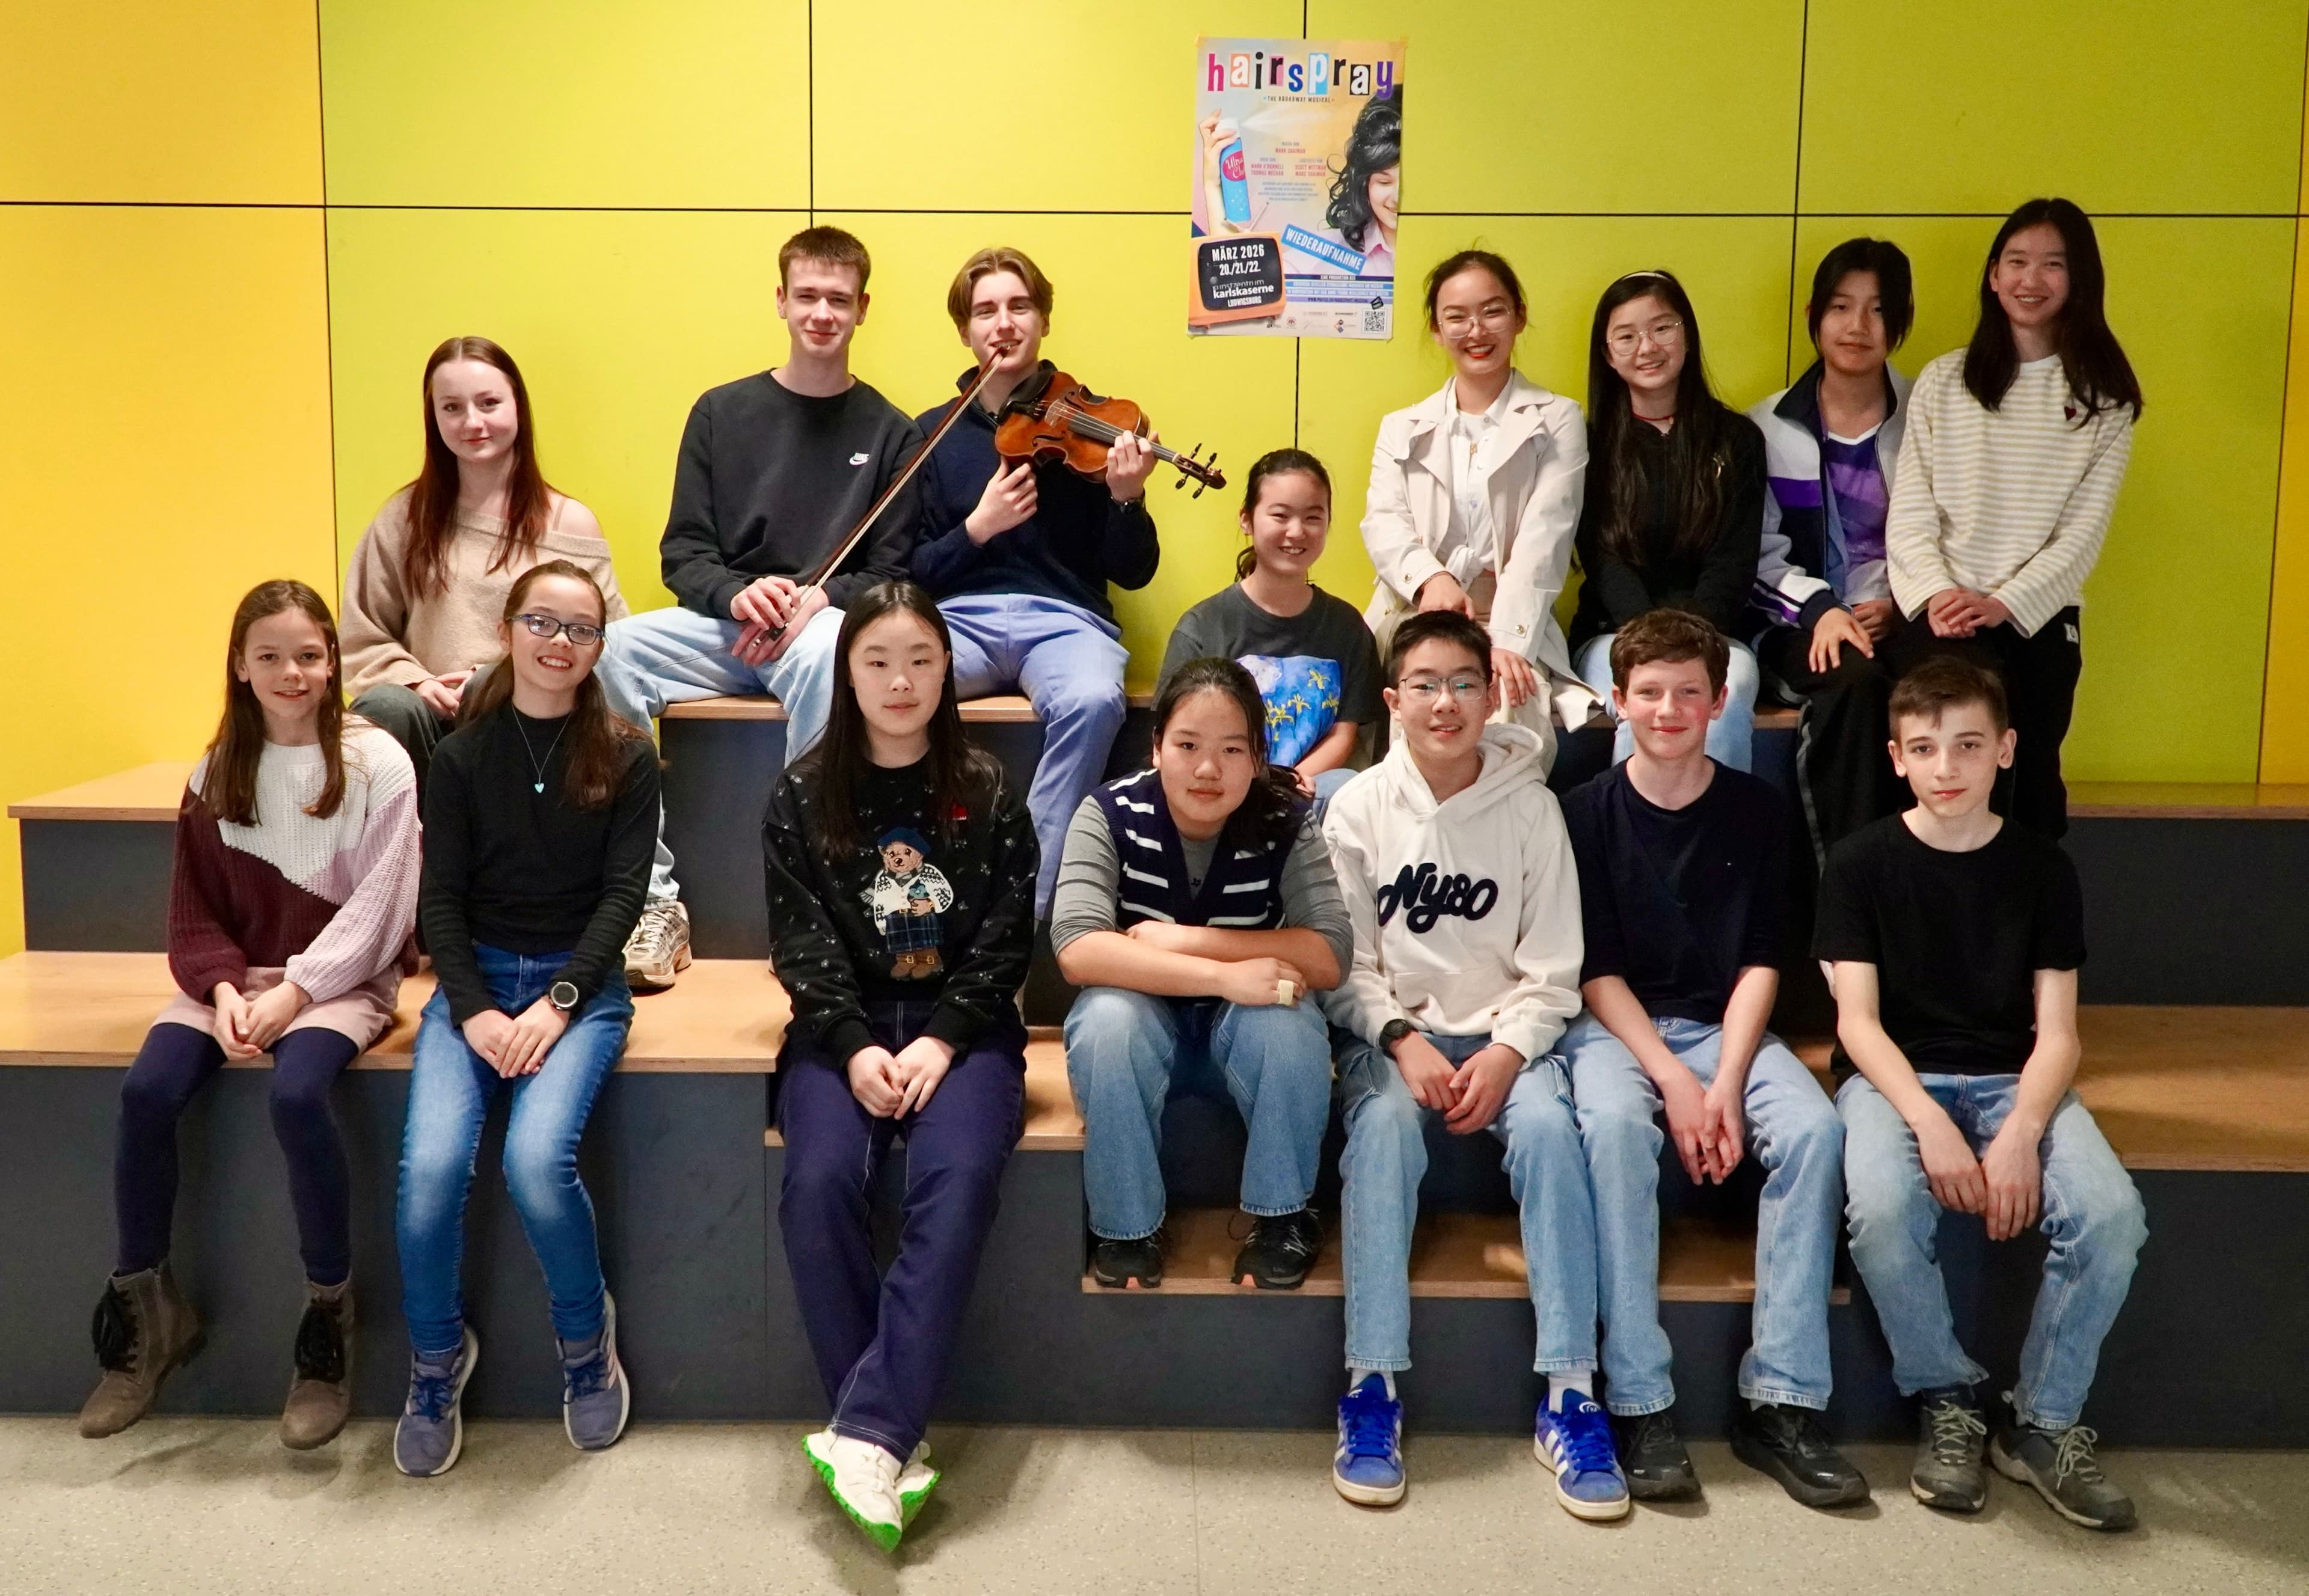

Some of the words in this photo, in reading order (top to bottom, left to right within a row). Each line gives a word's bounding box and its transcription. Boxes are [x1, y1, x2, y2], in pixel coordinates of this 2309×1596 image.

[1207, 52, 1393, 100] hairspray
[1212, 245, 1238, 261] MÄRZ
[1240, 244, 1265, 258] 2026
[1286, 228, 1363, 271] WIEDERAUFNAHME
[1213, 285, 1274, 299] karlskaserne
[1228, 296, 1262, 307] LUDWIGSBURG
[1377, 863, 1498, 934] Ny80
